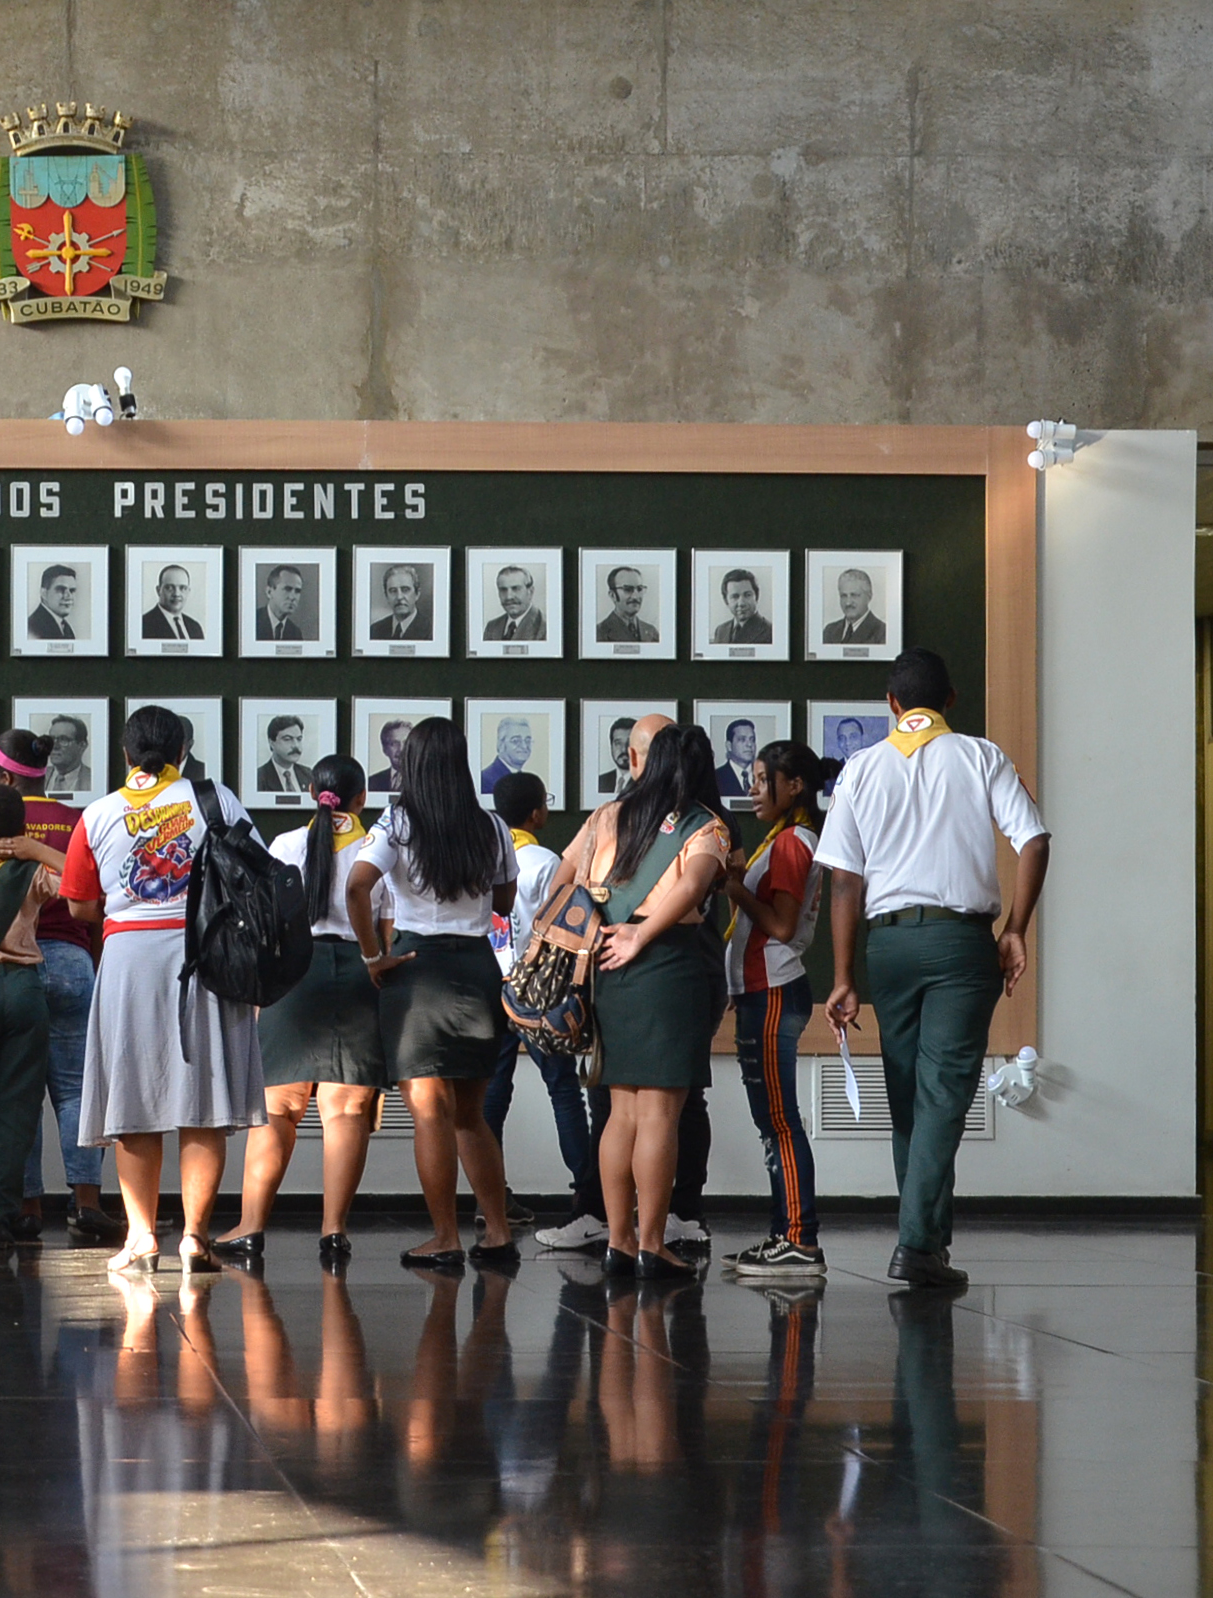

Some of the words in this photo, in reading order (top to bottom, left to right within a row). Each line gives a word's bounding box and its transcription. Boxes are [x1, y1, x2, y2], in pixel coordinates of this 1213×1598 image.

[124, 280, 163, 295] 1949
[19, 300, 121, 317] CUBATÃO
[113, 481, 426, 520] PRESIDENTES
